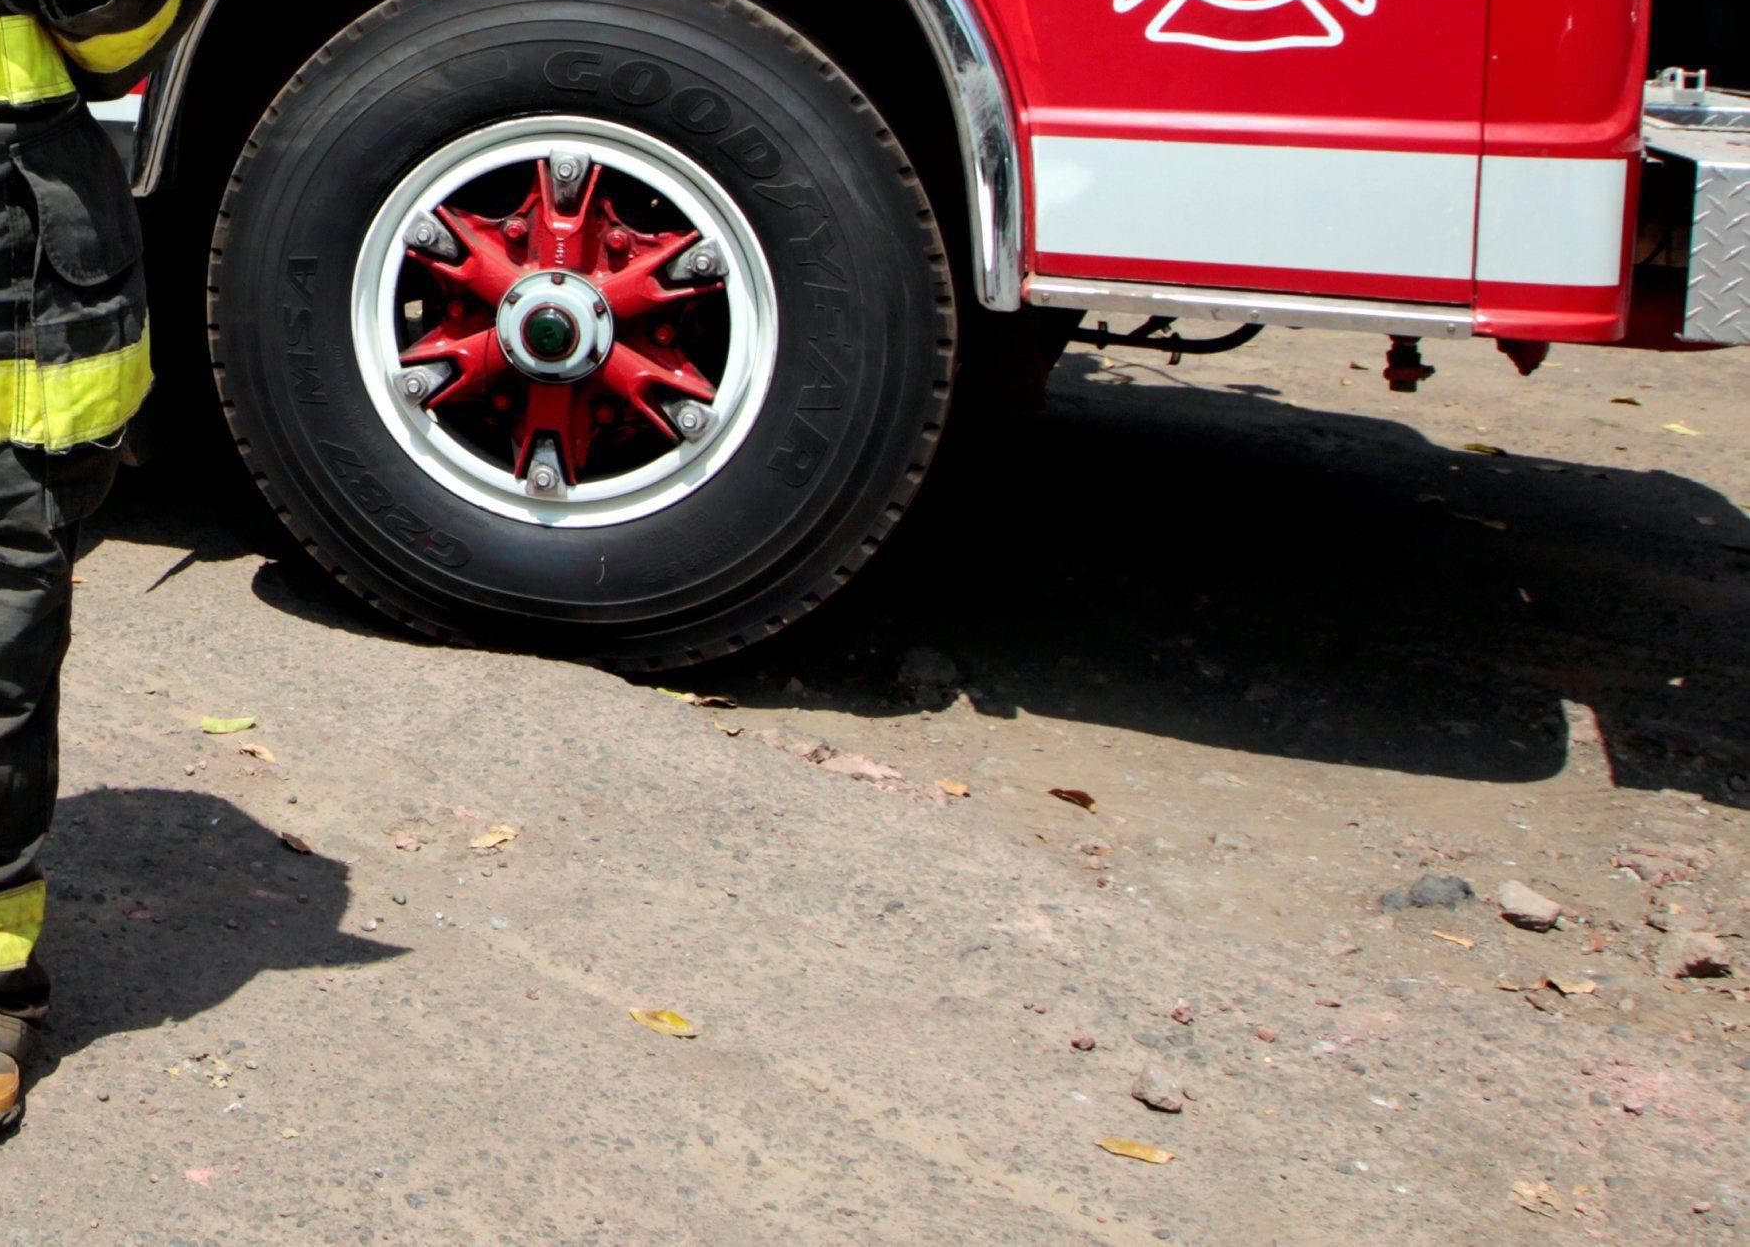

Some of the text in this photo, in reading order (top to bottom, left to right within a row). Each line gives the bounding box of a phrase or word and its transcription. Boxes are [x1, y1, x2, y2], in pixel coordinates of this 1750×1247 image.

[282, 256, 473, 568] G287 MSA
[543, 51, 850, 489] GOODYEAR
